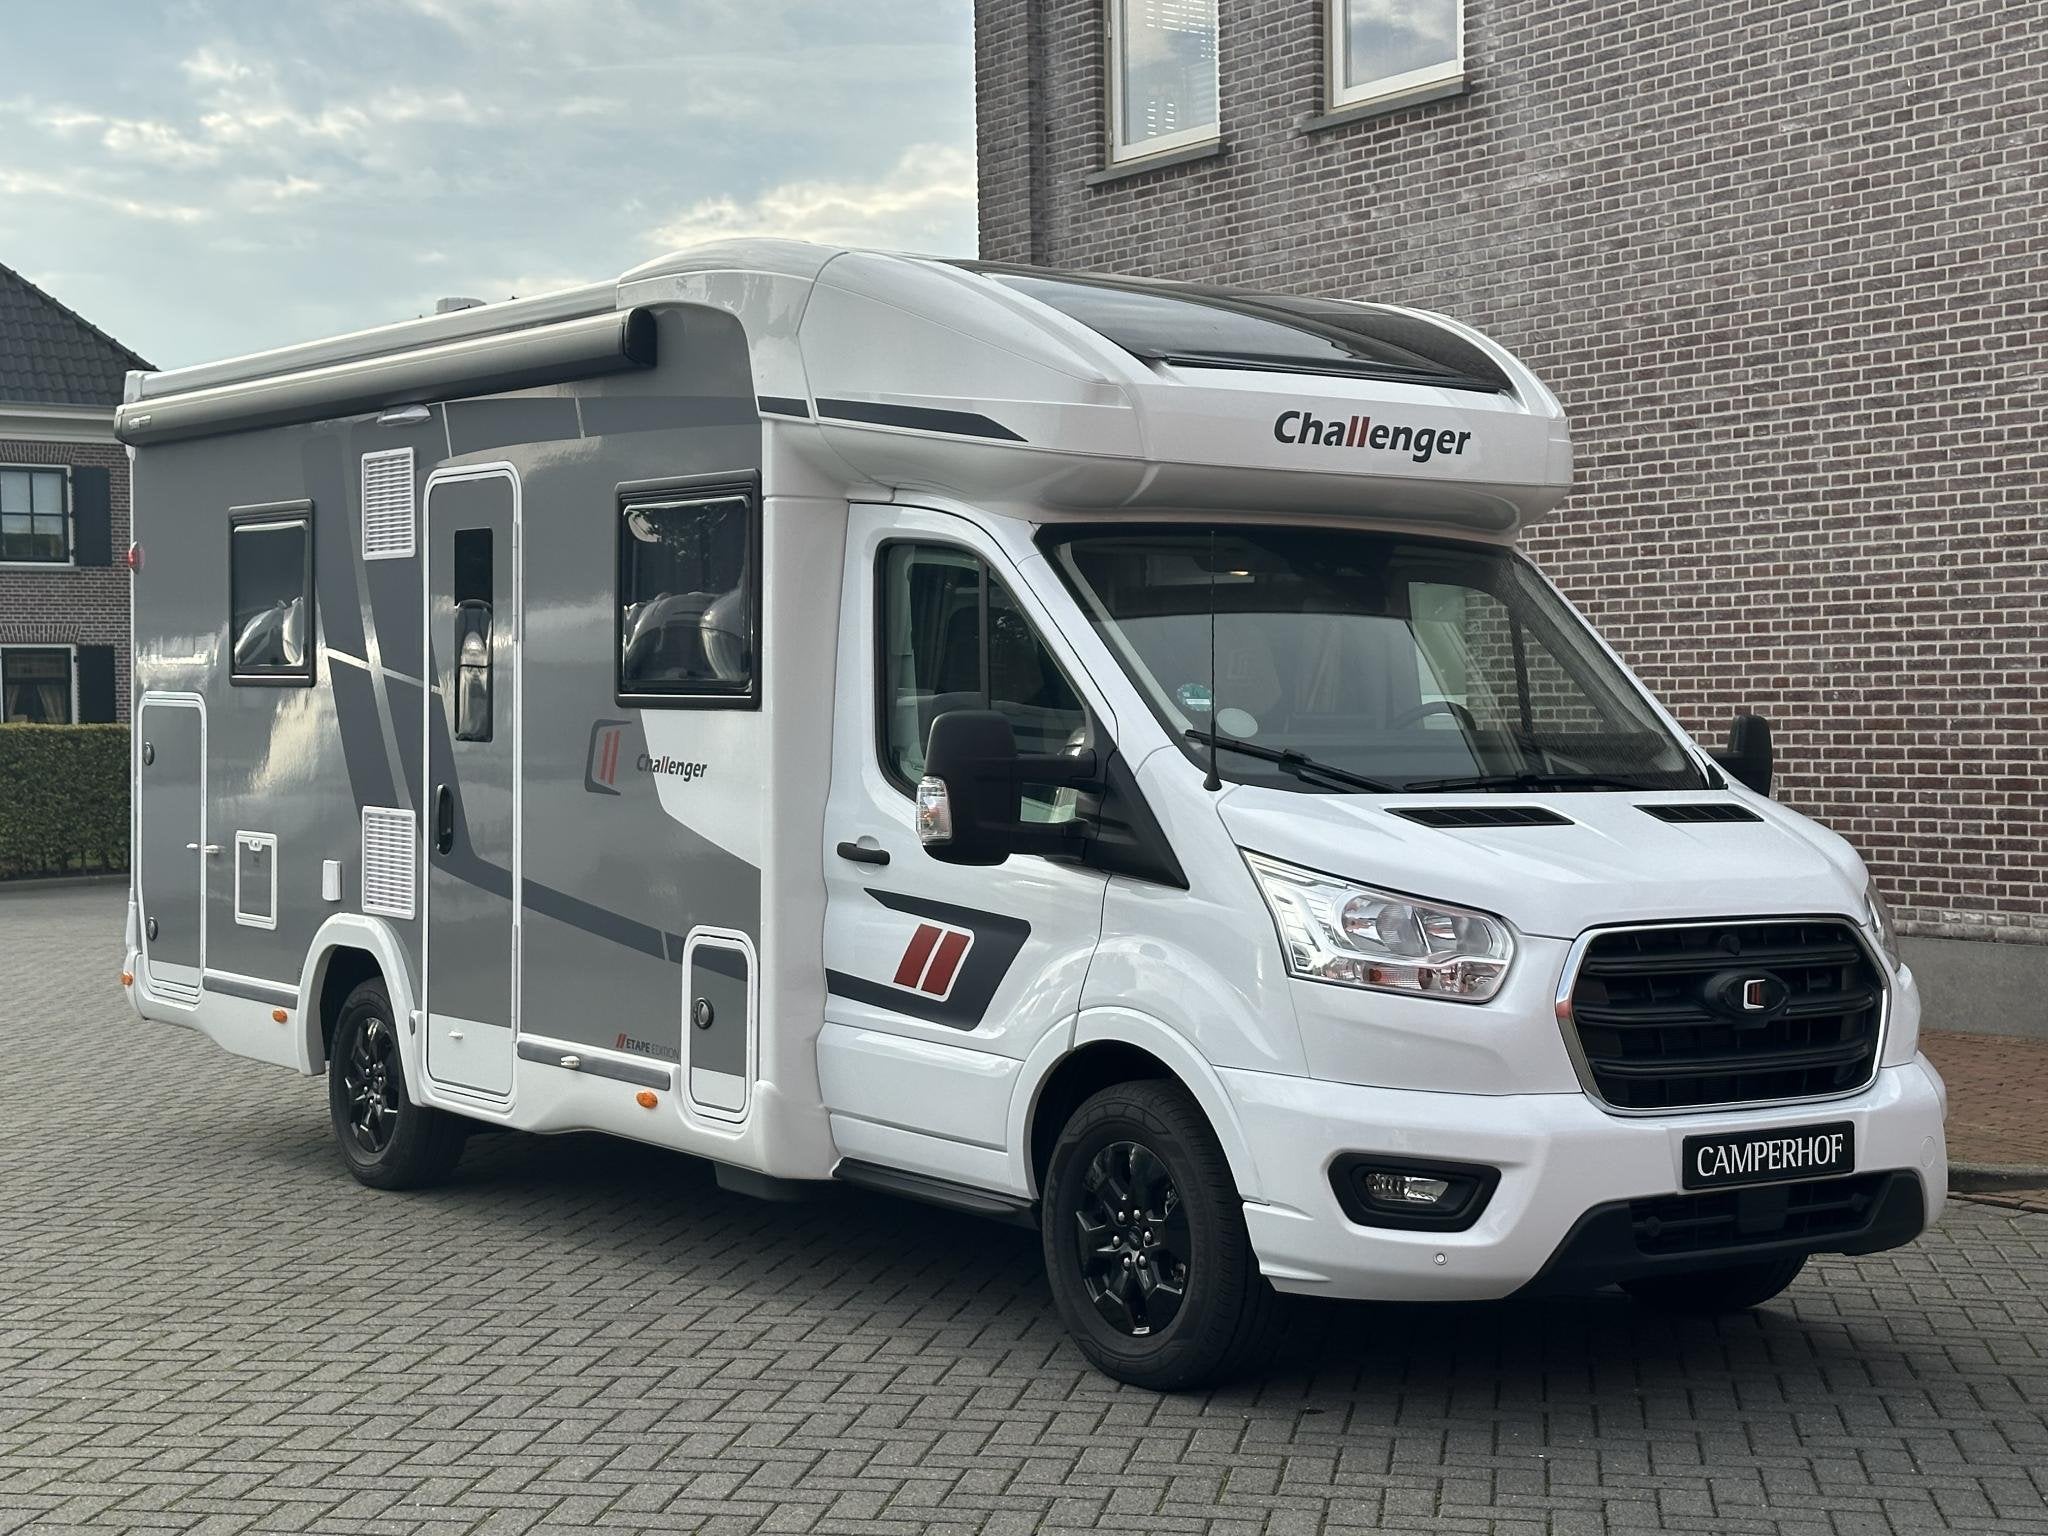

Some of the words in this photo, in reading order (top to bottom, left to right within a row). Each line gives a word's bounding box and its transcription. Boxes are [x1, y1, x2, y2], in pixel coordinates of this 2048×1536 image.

[1274, 410, 1471, 463] Challenger
[637, 753, 708, 782] Challenger
[626, 1038, 650, 1053] ETAPE
[1697, 1133, 1844, 1177] CAMPERHOF
